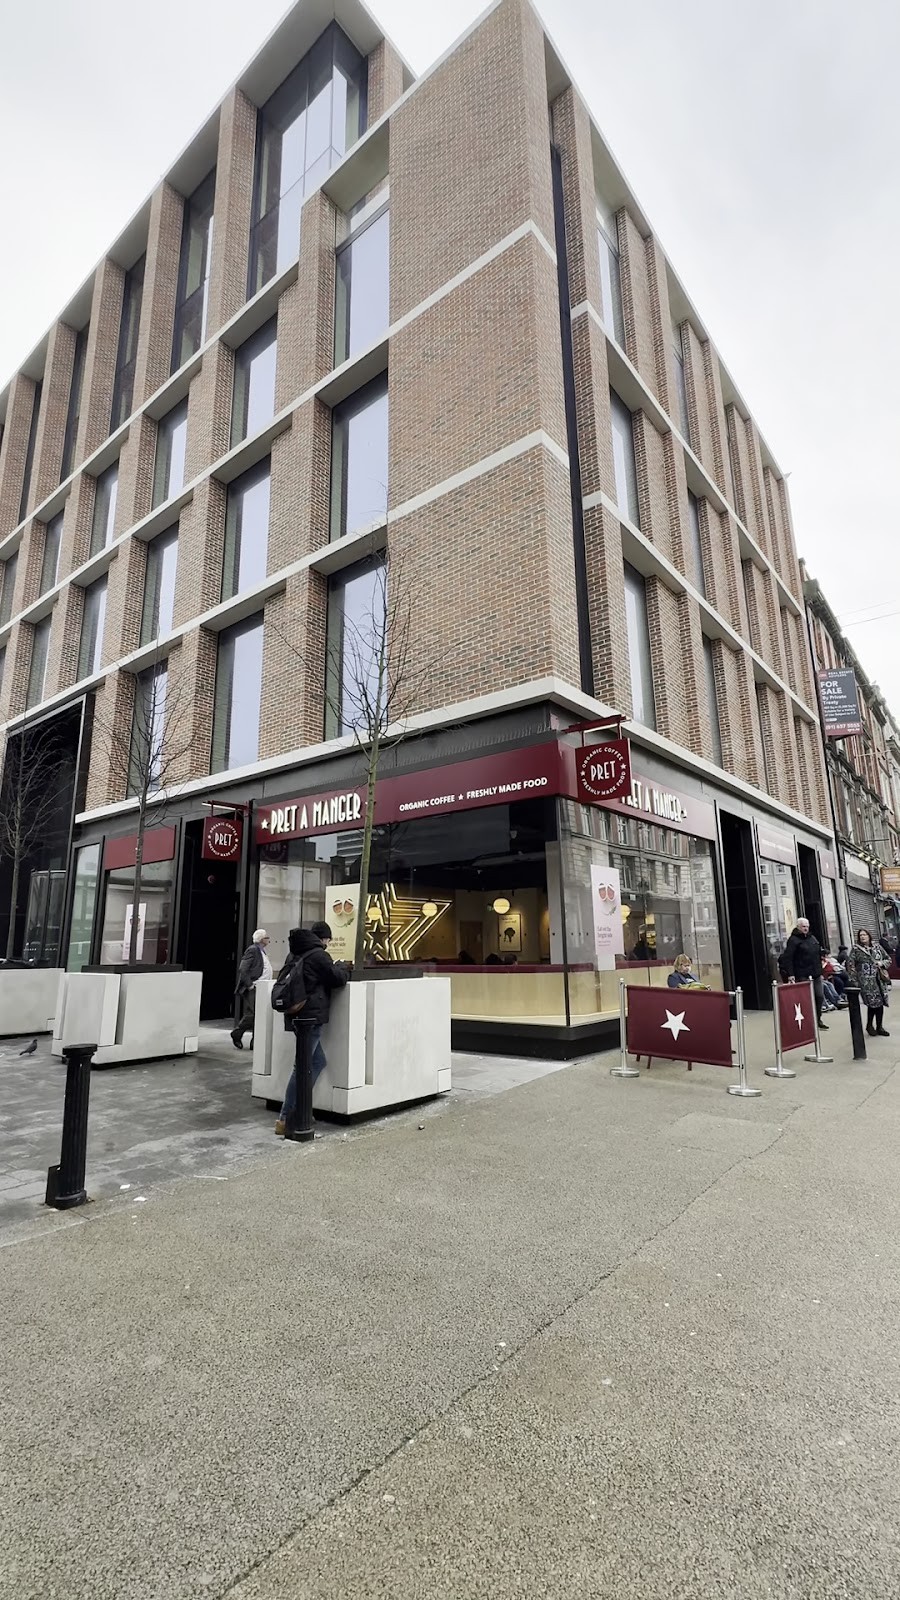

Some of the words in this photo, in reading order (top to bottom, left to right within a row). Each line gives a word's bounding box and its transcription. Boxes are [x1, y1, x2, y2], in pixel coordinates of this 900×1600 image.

[820, 680, 838, 688] FOR
[821, 687, 842, 695] SALE
[582, 748, 602, 769] ORGANIC
[604, 747, 624, 761] COFFEE
[590, 760, 616, 781] PRET
[399, 800, 429, 811] ORGANIC
[430, 795, 455, 806] COFFEE
[466, 787, 498, 799] FRESHLY
[498, 782, 522, 793] MADE
[523, 777, 548, 788] FOOD
[581, 778, 601, 795] FRESHLY
[601, 786, 617, 795] MADE
[616, 771, 626, 787] FOOD
[270, 805, 298, 835] PRET
[300, 804, 308, 829] A
[313, 793, 361, 827] MANGER
[645, 786, 651, 812] A
[653, 789, 682, 823] MANGER
[214, 832, 232, 846] PRET
